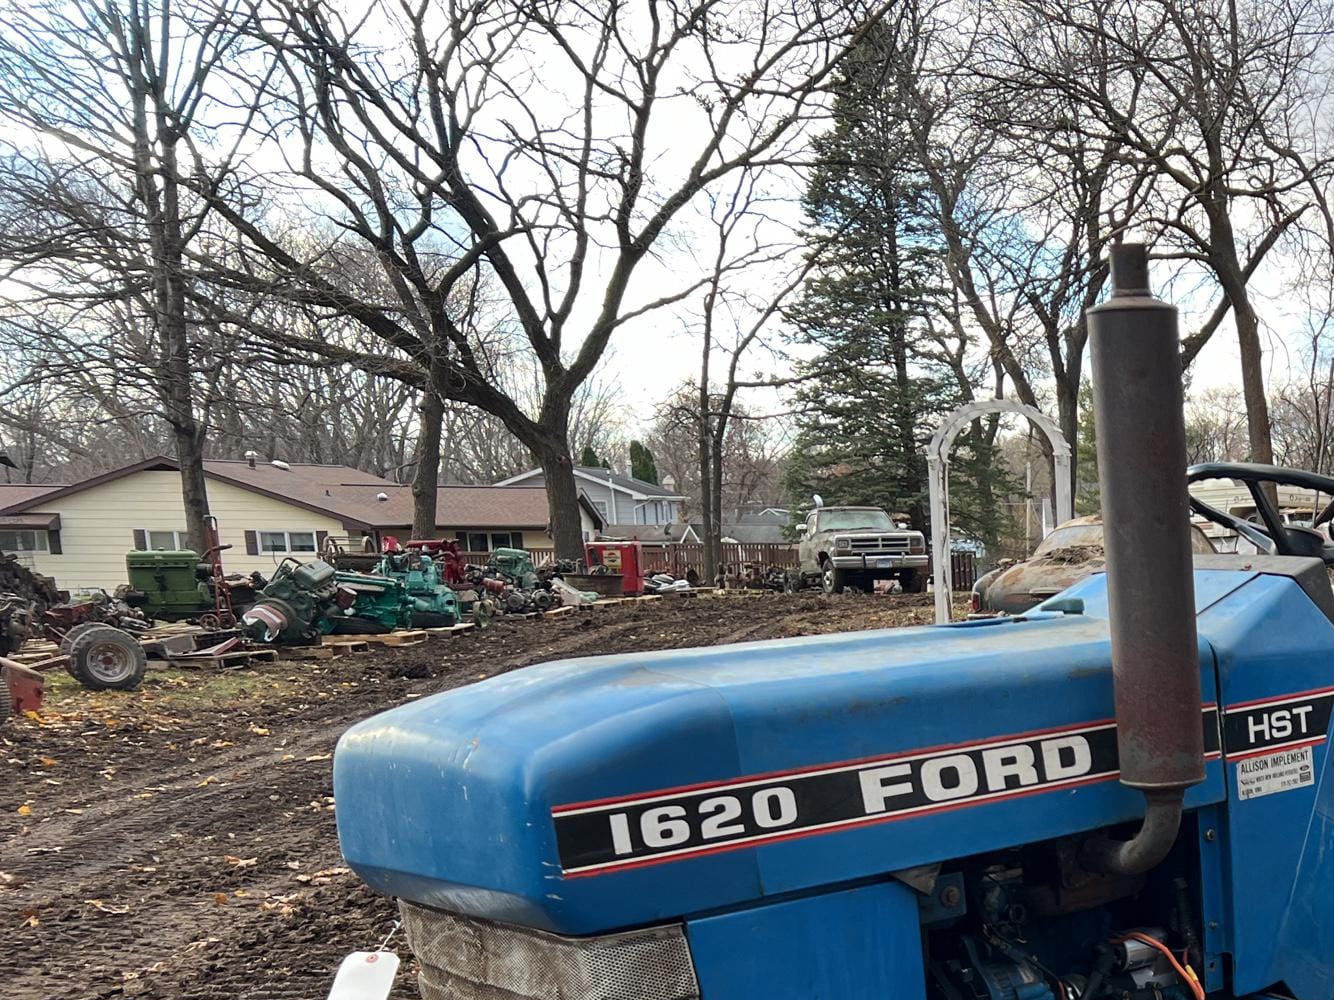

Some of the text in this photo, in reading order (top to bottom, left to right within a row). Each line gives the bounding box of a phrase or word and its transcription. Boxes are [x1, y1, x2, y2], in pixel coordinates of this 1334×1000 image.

[1247, 705, 1313, 744] HST
[1240, 750, 1309, 774] ALLISON IMPLEMENT
[608, 735, 1094, 856] 1620 FORD
